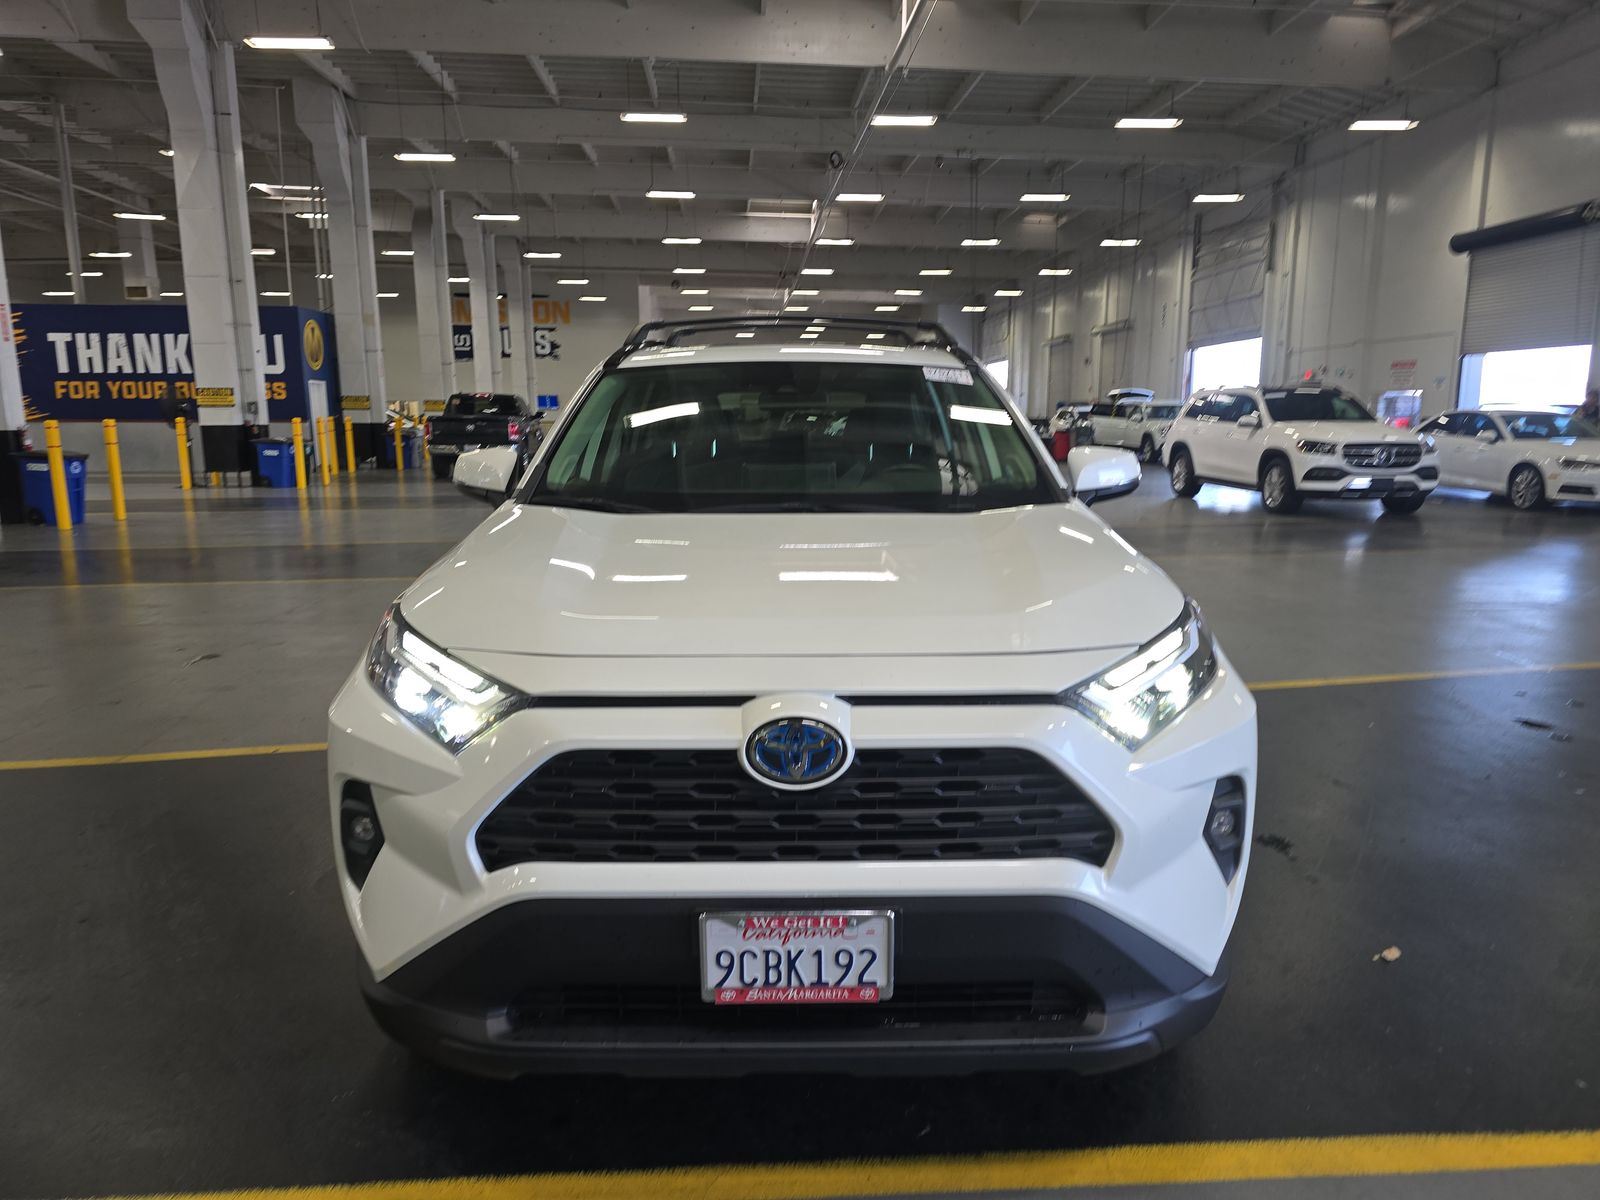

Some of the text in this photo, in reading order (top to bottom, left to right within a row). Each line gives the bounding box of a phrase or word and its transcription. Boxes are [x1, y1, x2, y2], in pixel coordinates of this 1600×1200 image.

[46, 332, 193, 374] THANK
[54, 381, 100, 400] FOR
[106, 381, 168, 400] YOUR
[742, 926, 847, 947] California
[714, 949, 878, 988] 9CBK192
